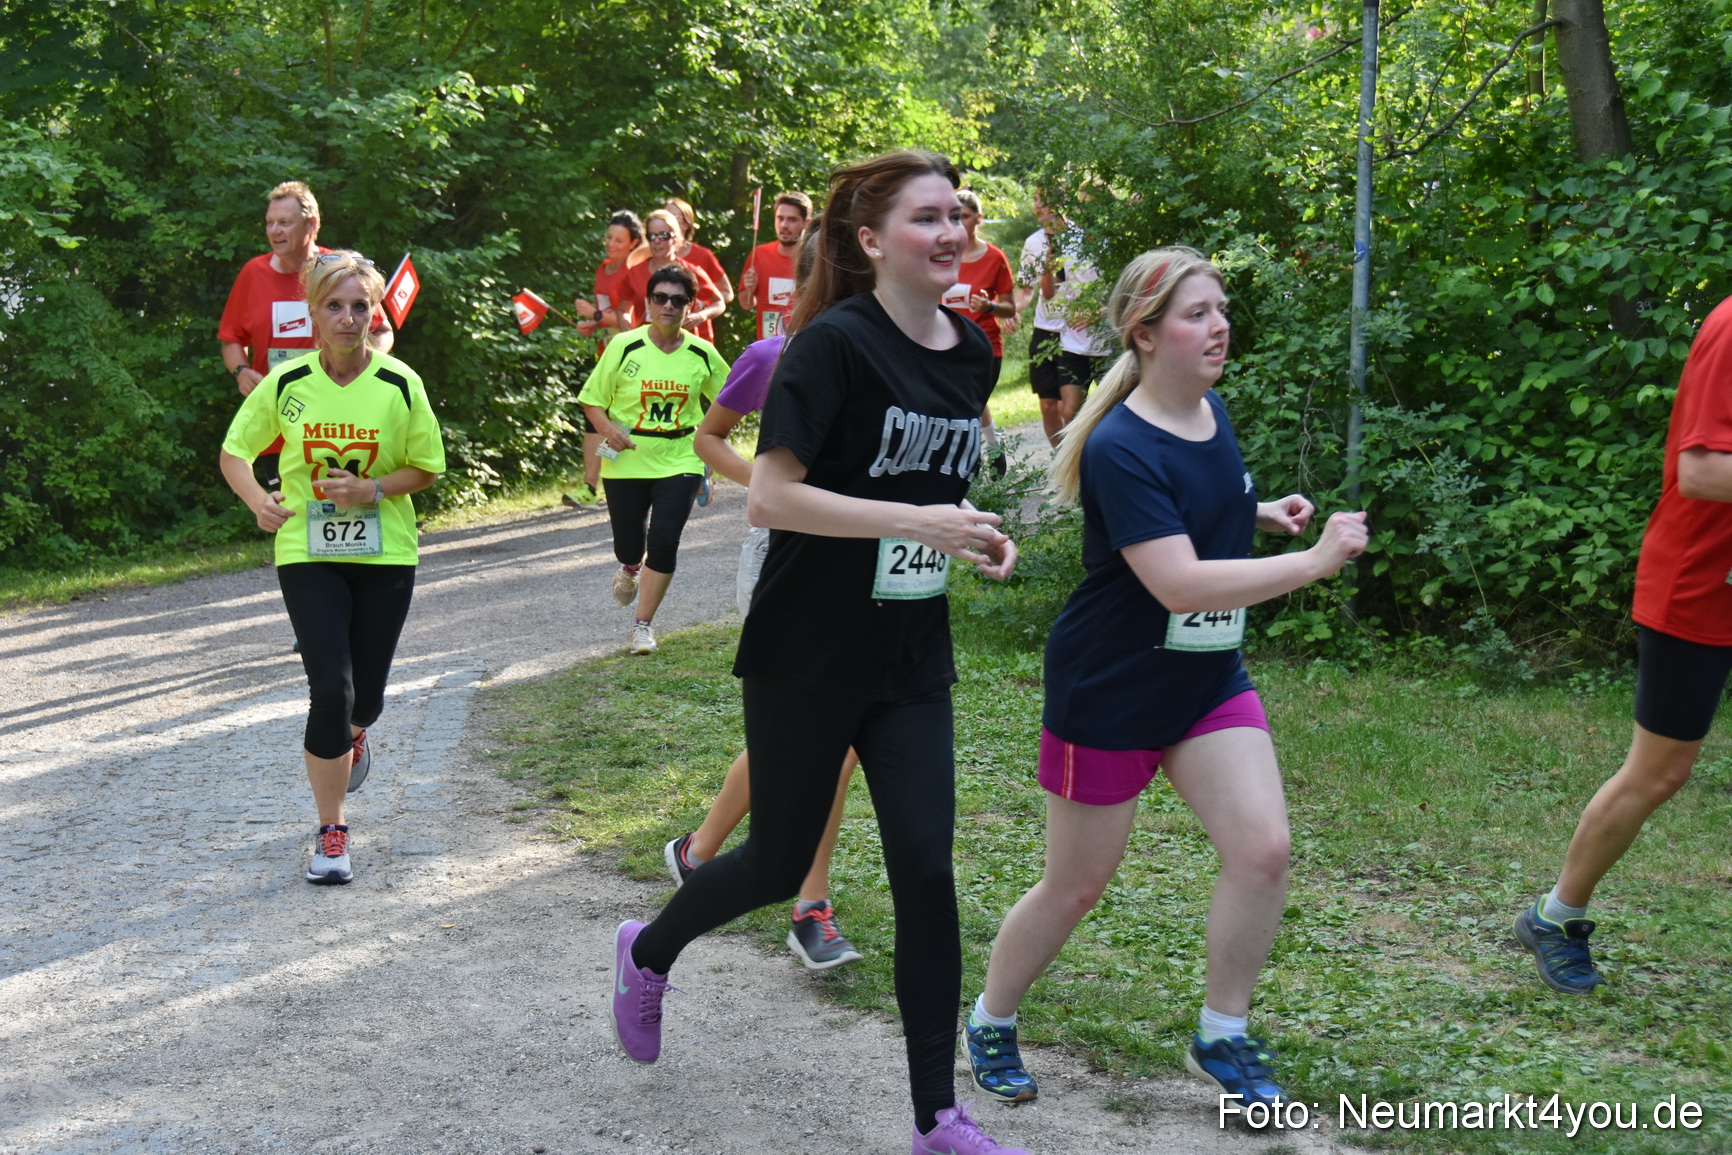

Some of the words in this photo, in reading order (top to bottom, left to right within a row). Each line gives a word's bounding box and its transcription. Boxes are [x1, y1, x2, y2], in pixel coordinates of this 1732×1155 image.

[641, 380, 690, 392] Müller
[648, 402, 675, 423] M
[303, 423, 379, 440] Müller
[869, 405, 982, 482] COMPTO
[323, 520, 366, 541] 672
[889, 544, 946, 574] 2448
[983, 1032, 1000, 1040] LICO
